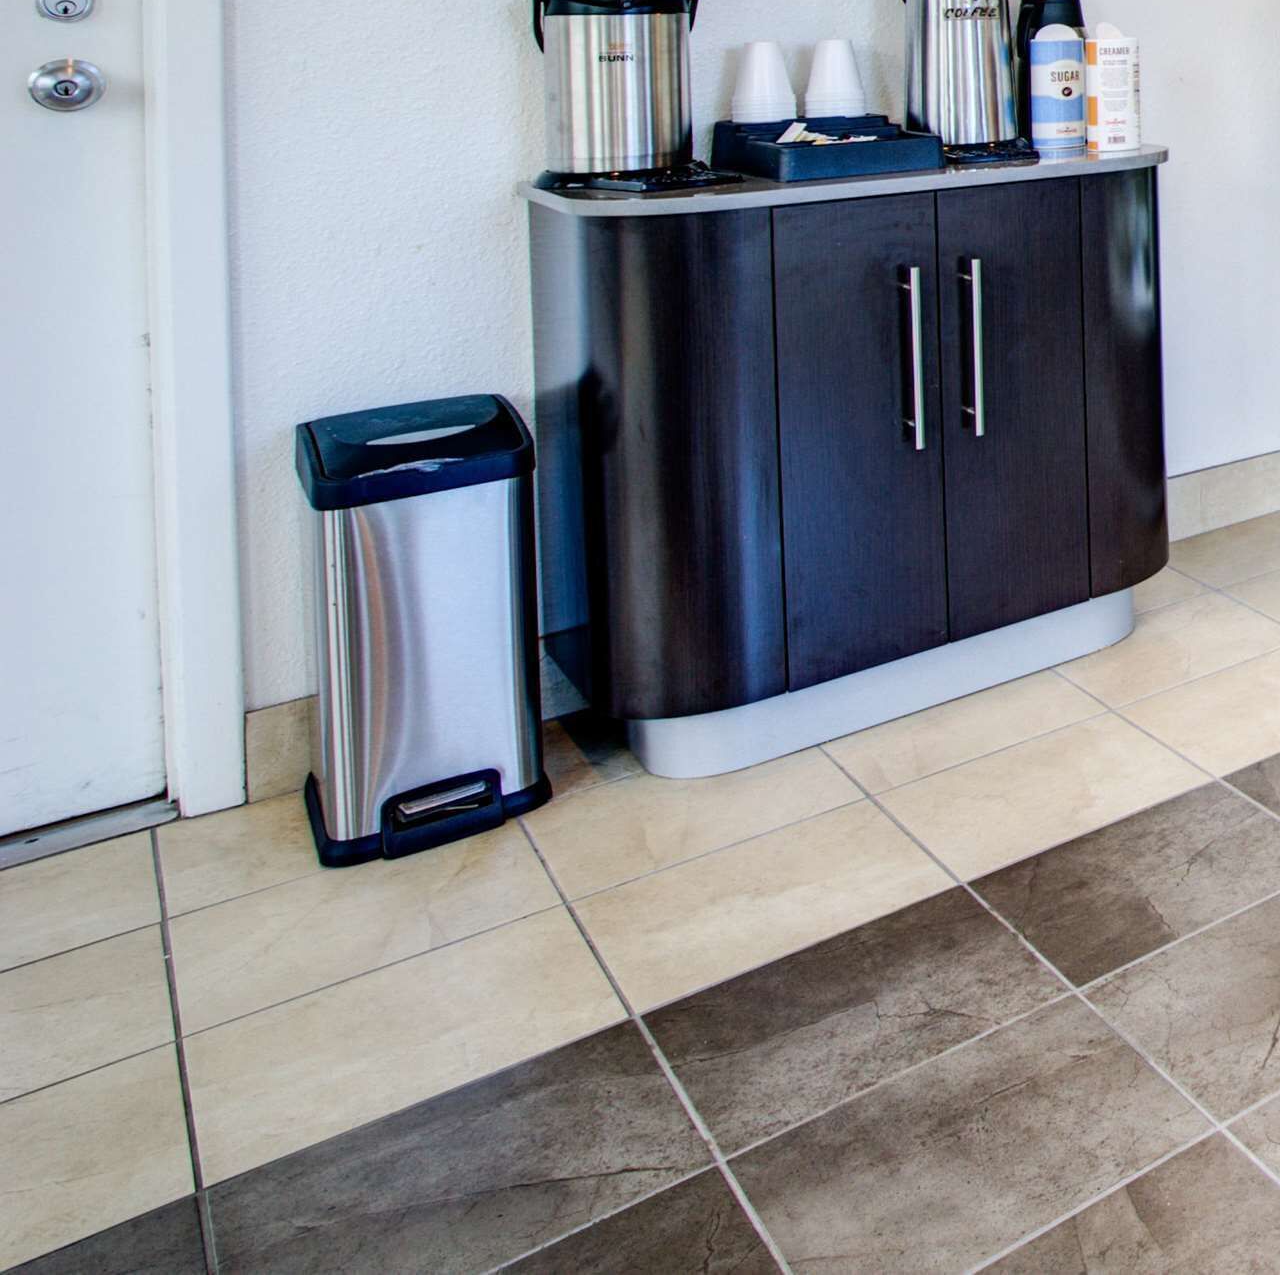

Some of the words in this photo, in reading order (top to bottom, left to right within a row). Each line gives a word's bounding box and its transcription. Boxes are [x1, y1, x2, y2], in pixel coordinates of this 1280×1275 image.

[944, 6, 998, 19] COFFEE
[1099, 46, 1131, 56] CREAMER
[598, 54, 635, 63] BUNN
[1050, 69, 1080, 83] SUGAR
